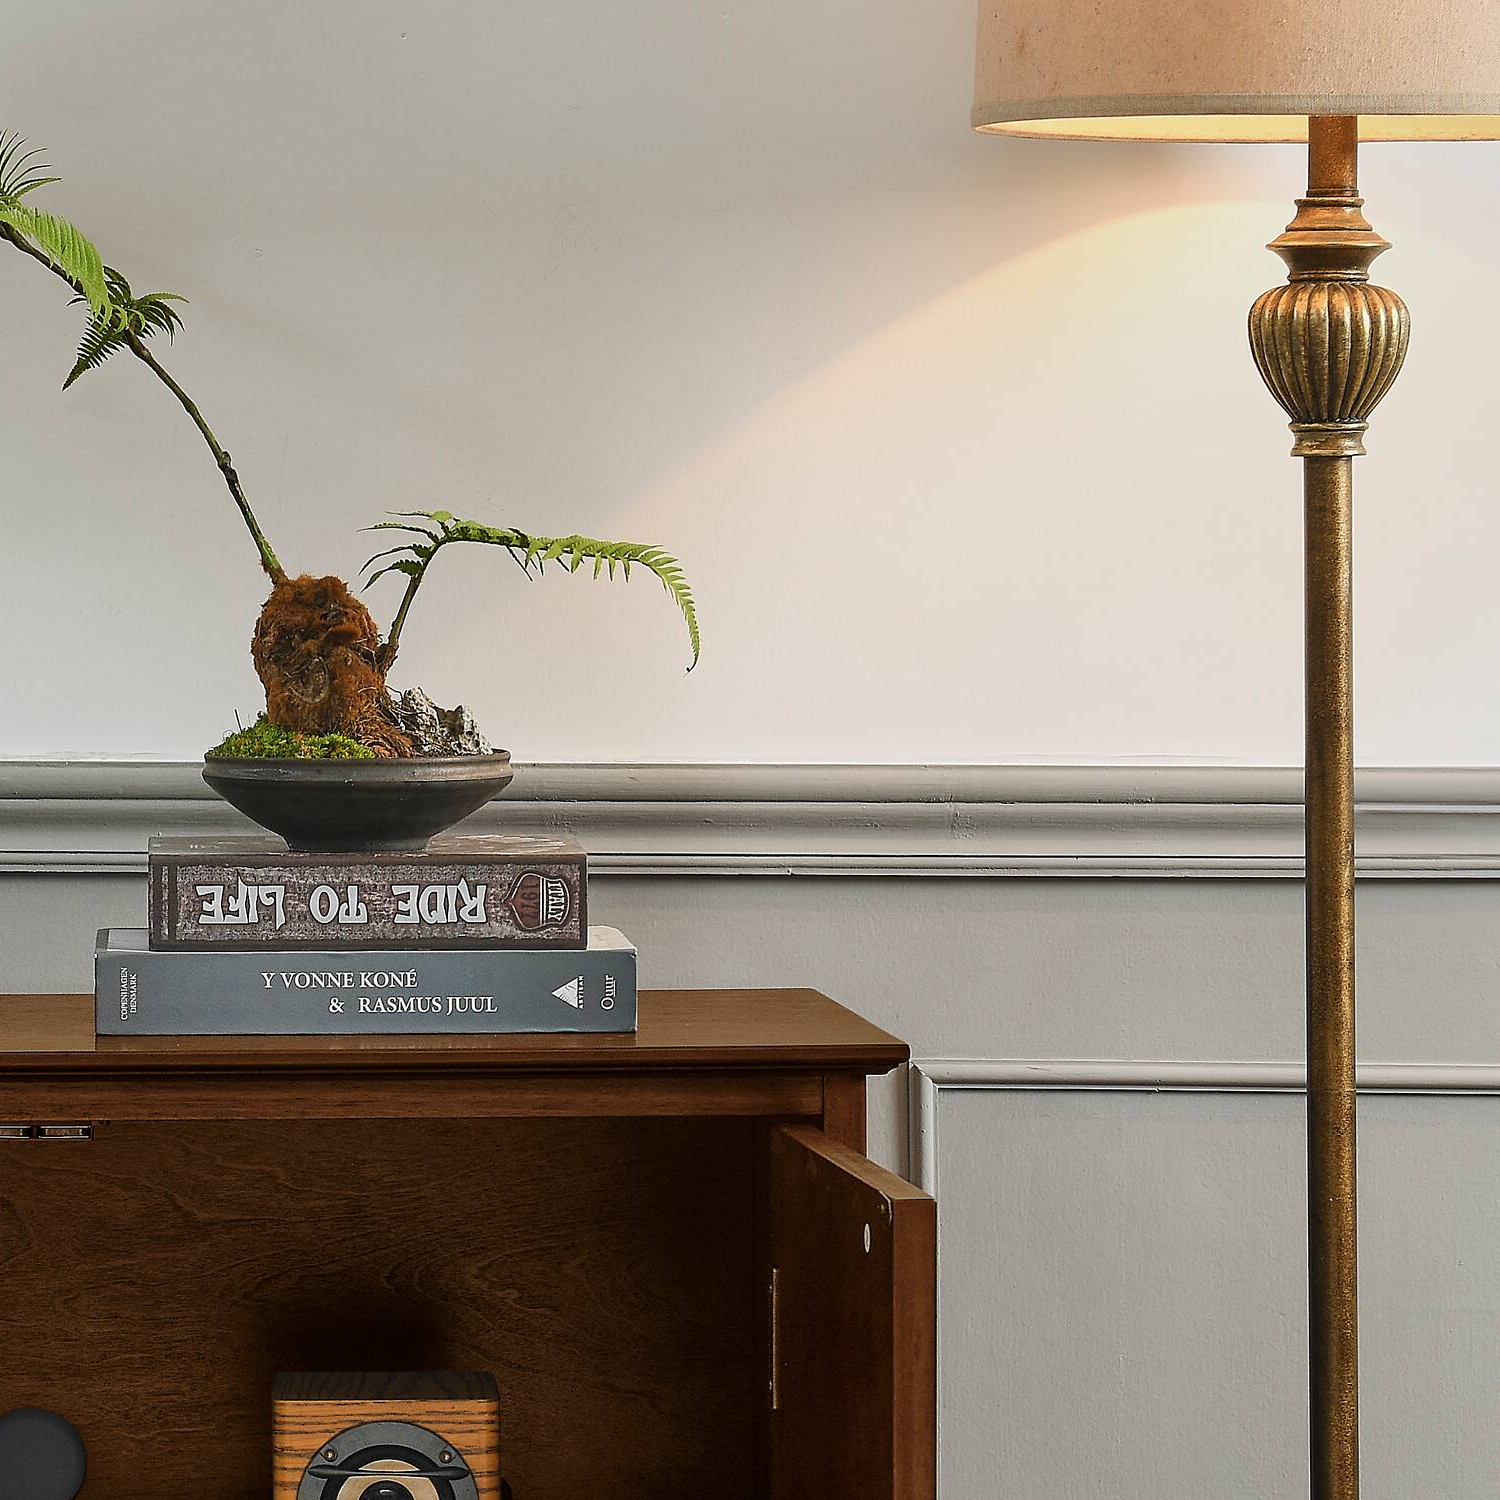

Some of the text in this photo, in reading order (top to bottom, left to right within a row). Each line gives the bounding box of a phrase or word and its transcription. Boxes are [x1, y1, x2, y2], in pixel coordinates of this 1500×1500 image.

[195, 872, 488, 931] RIDE TO LIFE
[547, 882, 565, 921] ITALY
[120, 967, 128, 1021] COPENHAGEN
[129, 973, 137, 1013] DENMARK
[359, 968, 418, 988] KONÉ
[600, 974, 616, 1010] Ouur
[328, 996, 498, 1016] & RASMUS JUUL
